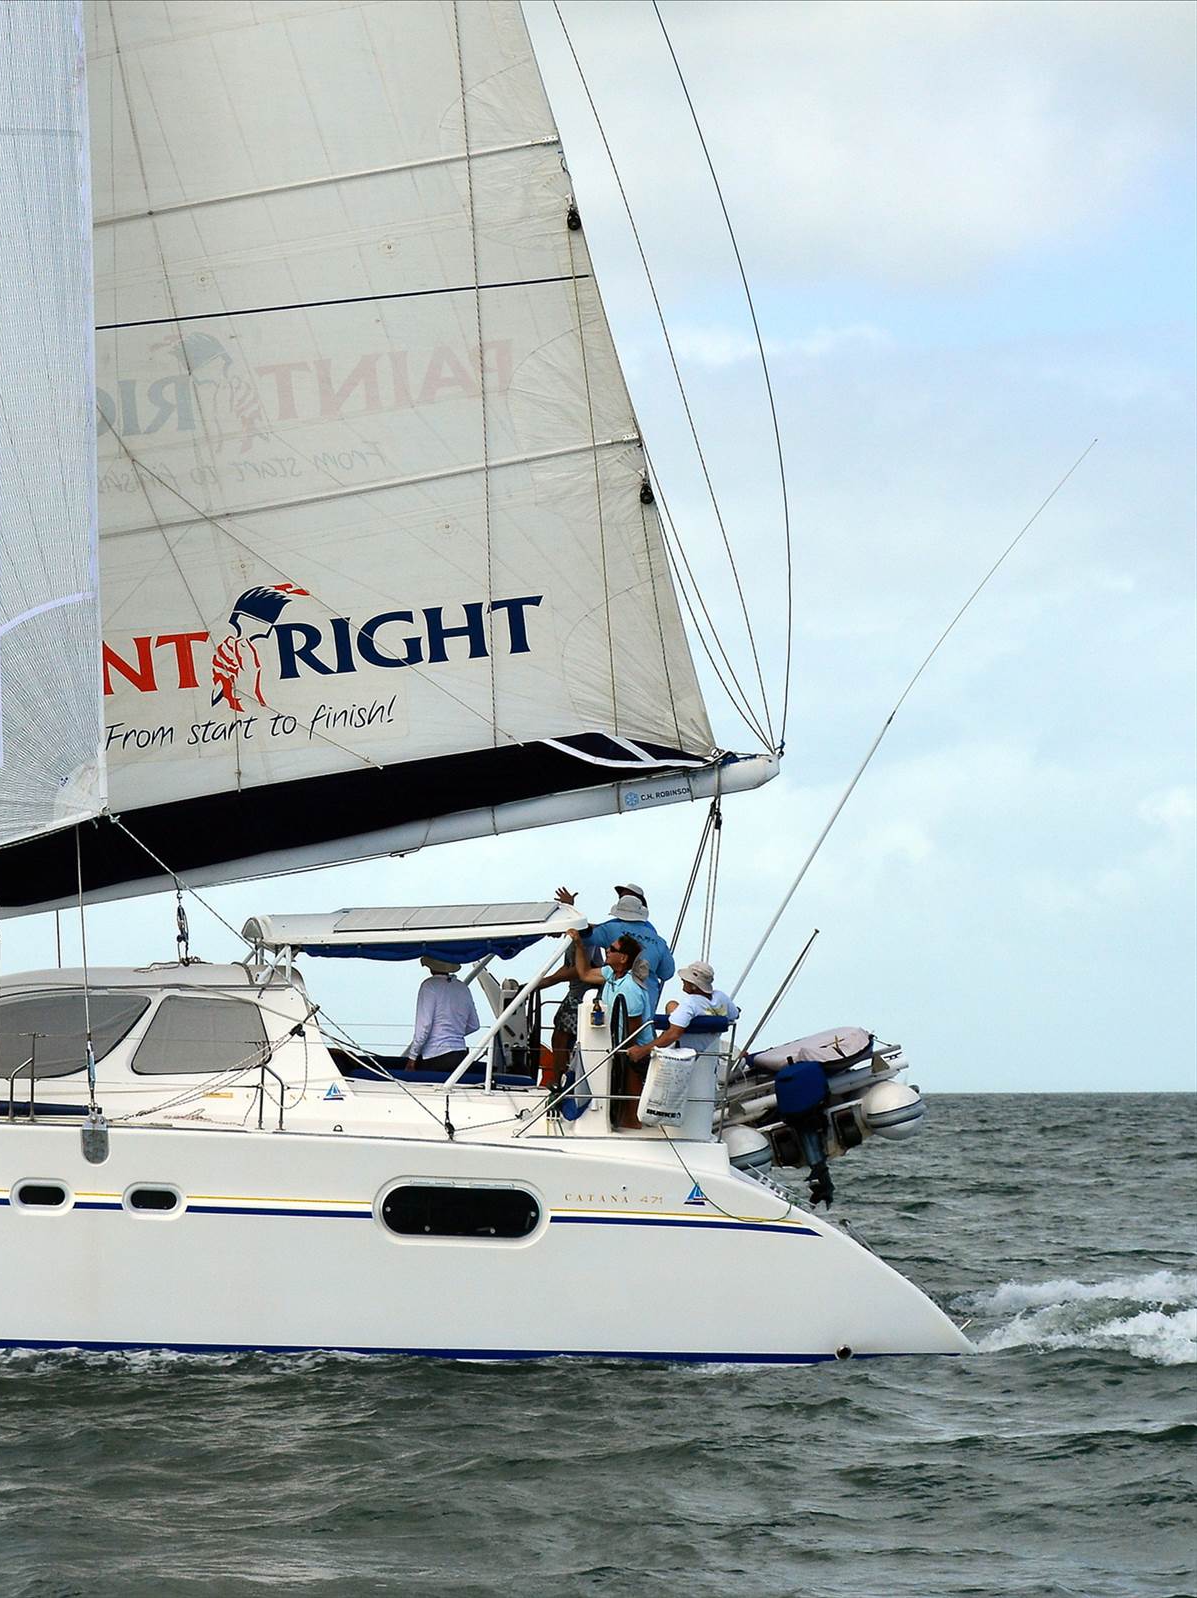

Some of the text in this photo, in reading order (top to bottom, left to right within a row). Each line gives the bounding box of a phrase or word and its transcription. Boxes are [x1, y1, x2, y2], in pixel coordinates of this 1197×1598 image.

[102, 595, 544, 696] NT RIGHT
[105, 694, 397, 751] From start to finish!
[655, 787, 691, 798] ROBINSON
[564, 1193, 664, 1205] CATANA 471
